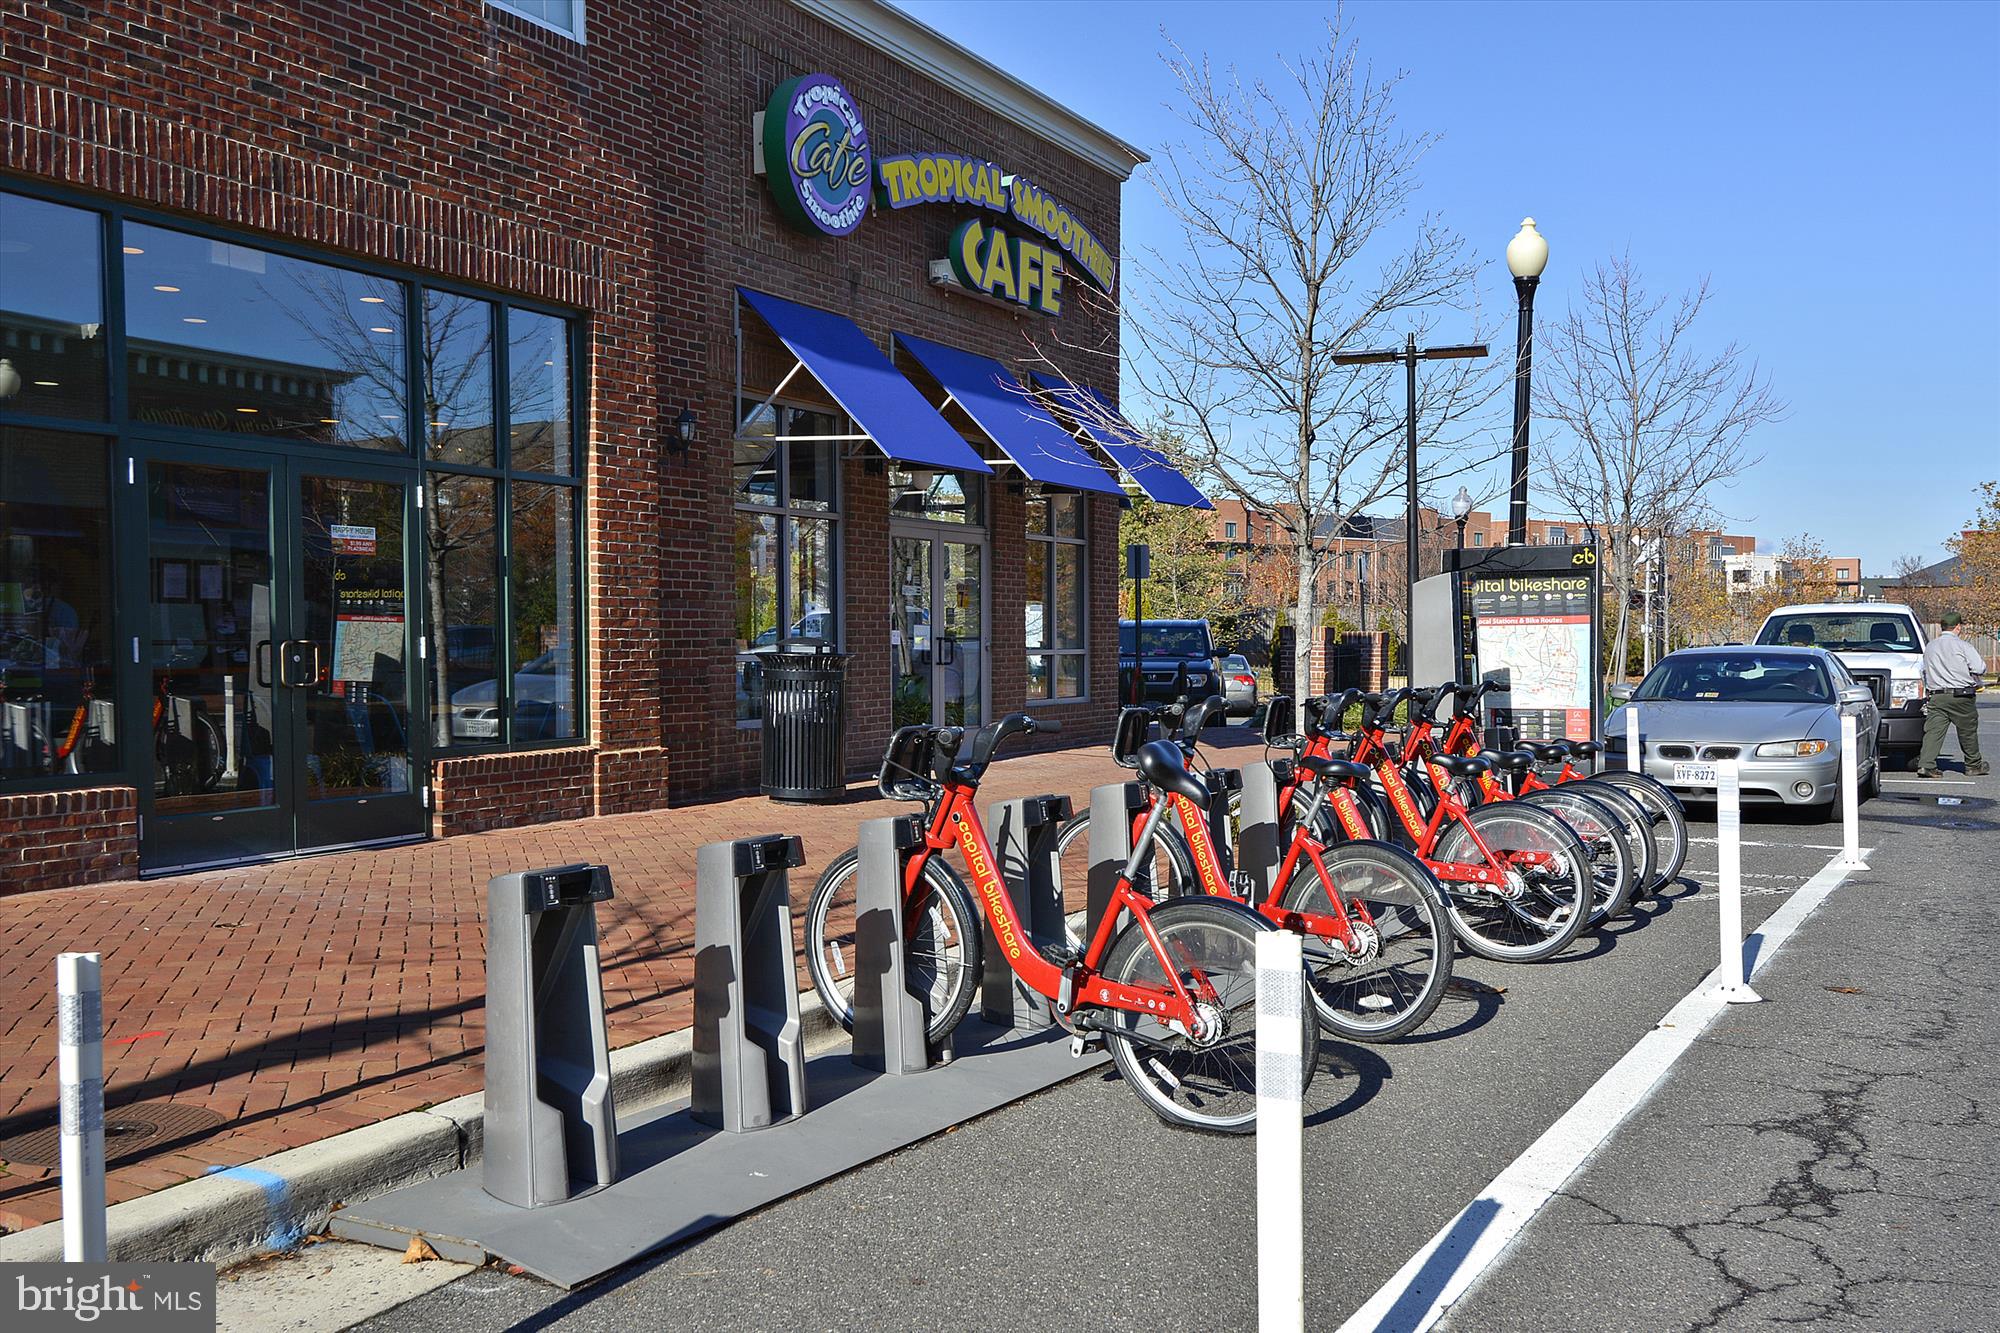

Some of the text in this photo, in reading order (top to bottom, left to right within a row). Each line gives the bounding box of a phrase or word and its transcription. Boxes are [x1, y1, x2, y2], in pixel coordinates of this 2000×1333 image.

[793, 85, 863, 137] Tropical
[790, 121, 869, 189] Café
[800, 178, 865, 229] Smoothie
[881, 159, 1114, 289] TROPICAL SMOOTHIE
[962, 220, 1062, 314] CAFE
[1509, 576, 1587, 593] bikeshare
[1393, 786, 1422, 837] bikeshare
[959, 821, 1021, 960] capital bikeshare
[1191, 829, 1218, 896] bikeshare
